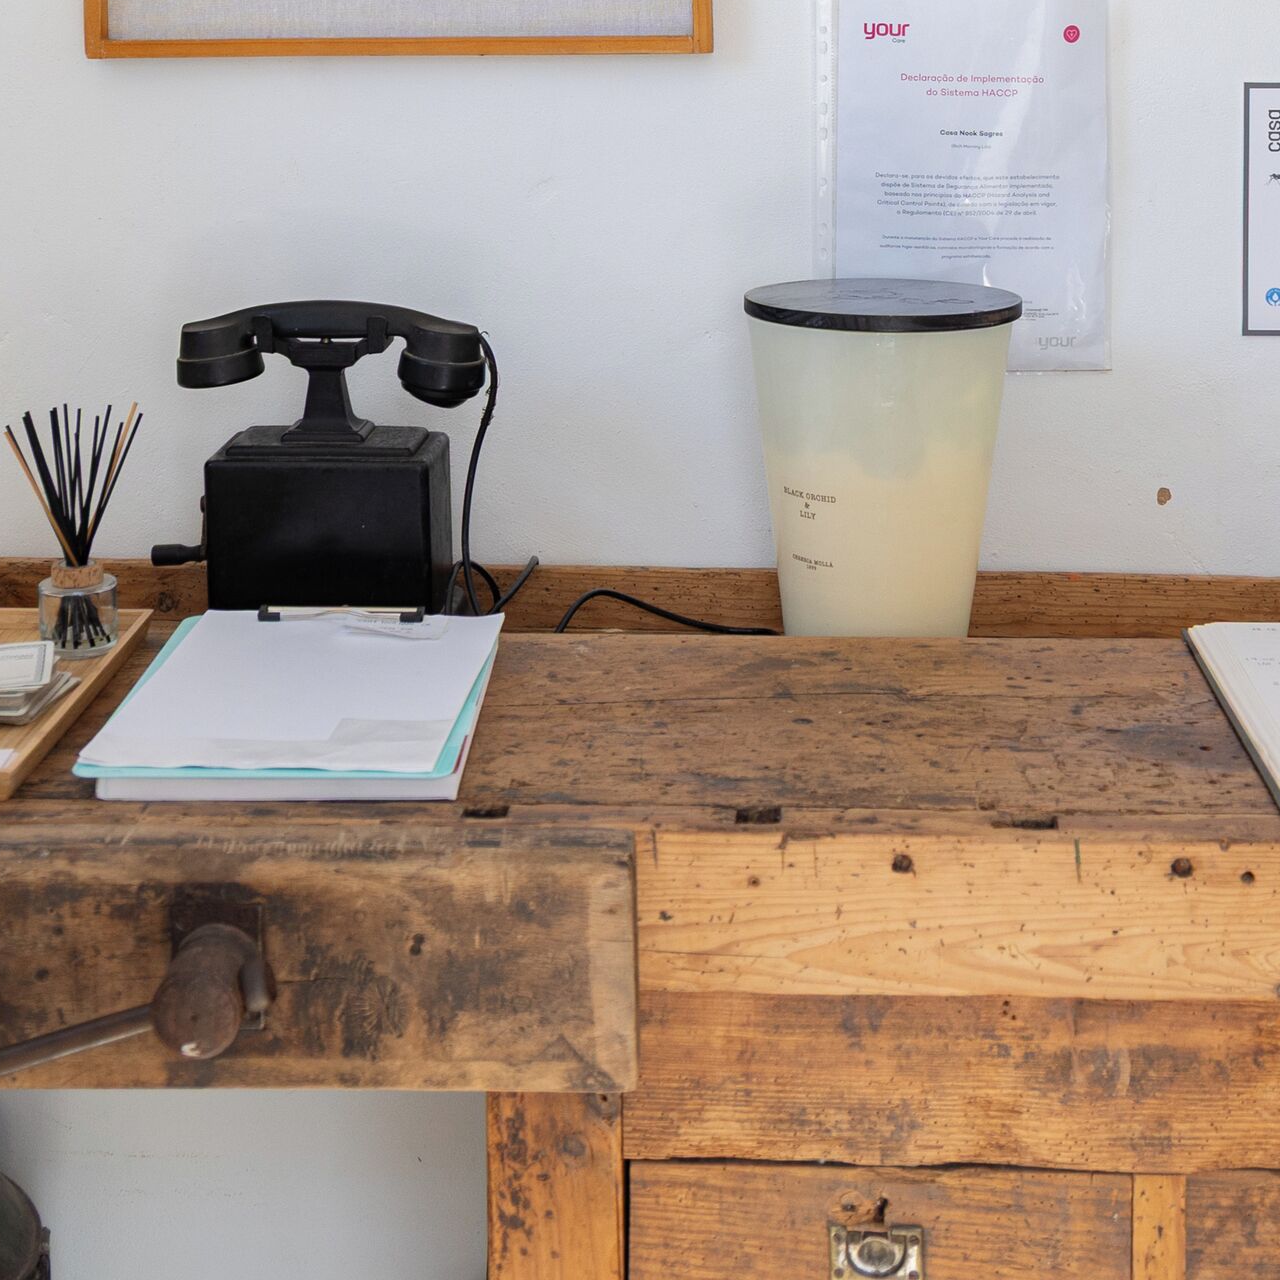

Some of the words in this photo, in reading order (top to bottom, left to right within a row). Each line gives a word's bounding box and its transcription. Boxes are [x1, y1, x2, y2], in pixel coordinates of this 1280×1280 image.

[863, 22, 910, 40] your
[900, 73, 954, 83] Declaração
[956, 74, 968, 83] de
[971, 74, 1045, 85] Implementação
[926, 88, 938, 96] do
[940, 88, 979, 97] Sistema
[981, 89, 1018, 97] HACCP
[979, 130, 1003, 138] Sagres
[1039, 336, 1076, 350] your
[783, 486, 804, 499] BLACK
[806, 492, 837, 503] ORCHID
[800, 510, 816, 520] LILY
